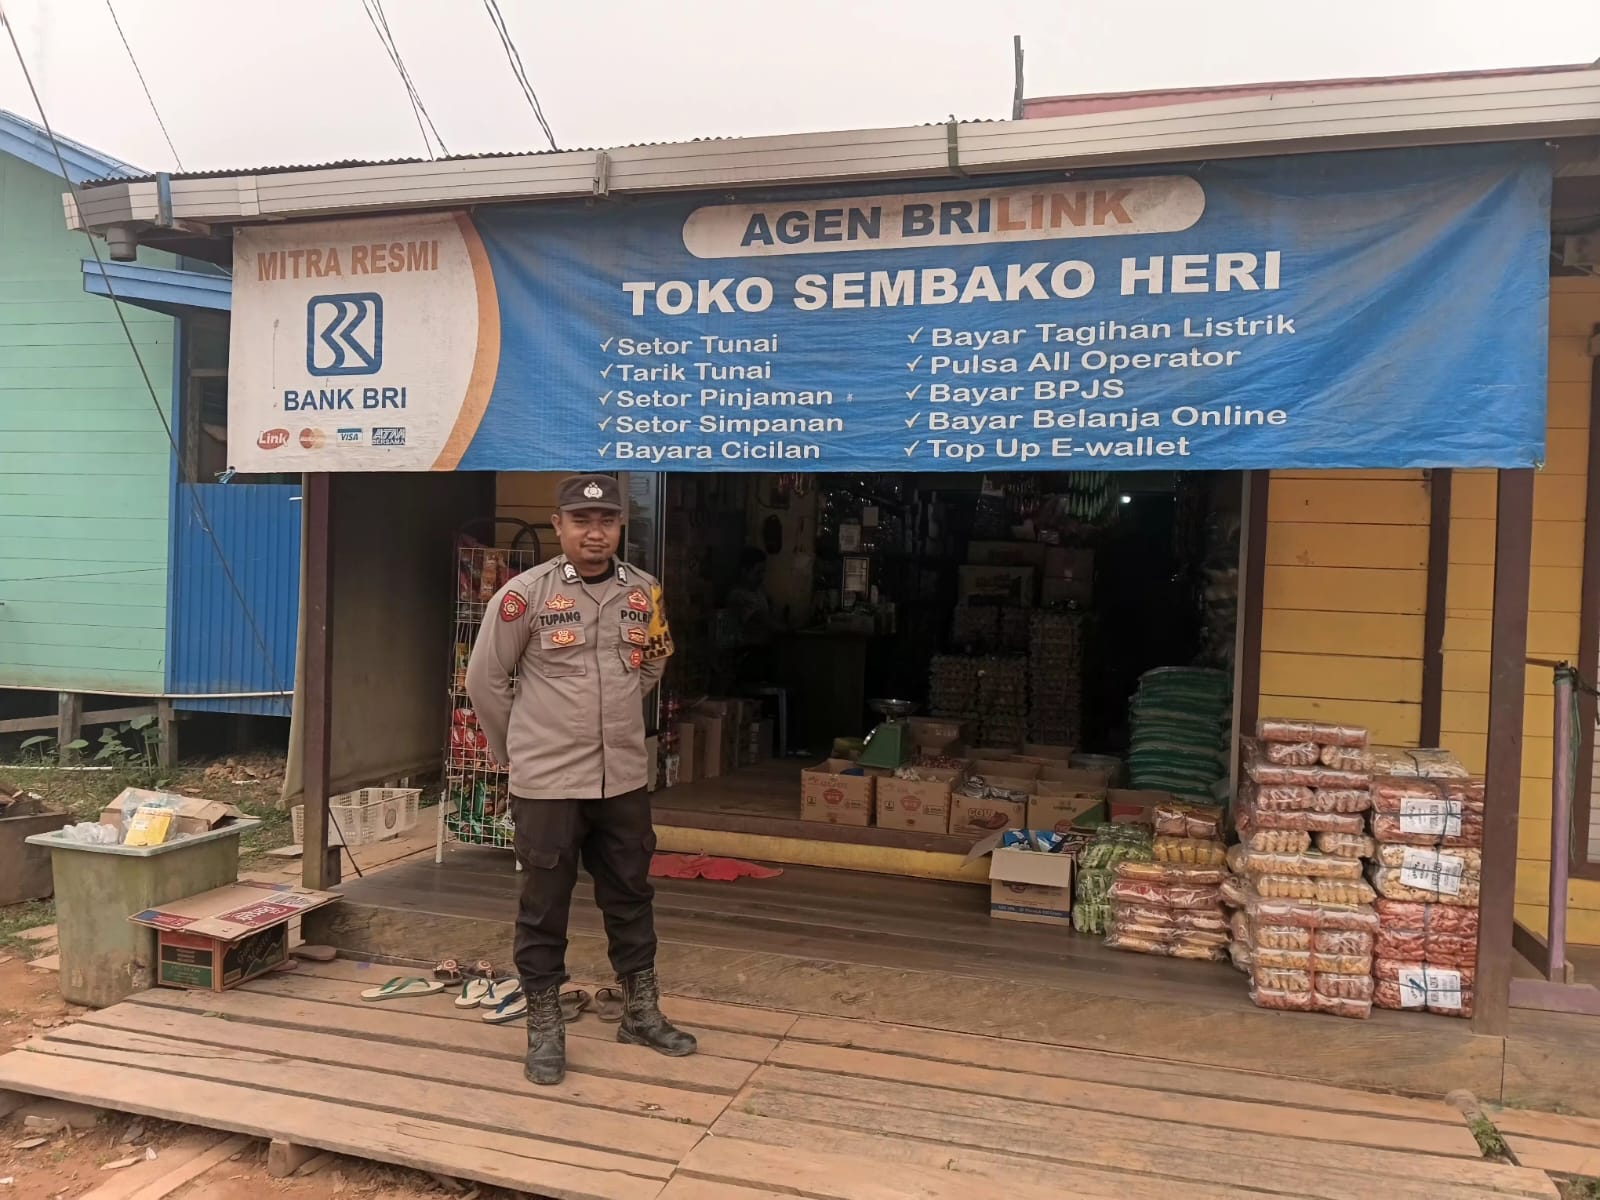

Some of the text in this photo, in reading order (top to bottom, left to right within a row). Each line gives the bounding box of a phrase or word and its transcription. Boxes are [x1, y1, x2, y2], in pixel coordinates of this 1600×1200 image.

[740, 190, 1133, 248] AGEN BRILINK
[257, 240, 439, 281] MITRA RESMI
[623, 251, 1280, 315] TOKO SEMBAKO HERI
[618, 334, 777, 355] Setor Tunai
[933, 315, 1295, 350] Bayar Tagihan Listrik
[617, 362, 770, 381] Tarik Tunai
[931, 349, 1241, 374] Pulsa All Operator
[284, 387, 407, 411] BANK BRI
[617, 389, 832, 410] Setor Pinjaman
[930, 379, 1123, 406] Bayar BPJS
[616, 416, 842, 436] Setor Simpanan
[929, 406, 1286, 434] Bayar Belanja Online
[258, 430, 290, 447] Link
[341, 433, 358, 441] VISA
[616, 441, 819, 463] Bayara Cicilan
[927, 437, 1190, 462] Top Up E-wallet
[539, 611, 581, 626] TUPANG
